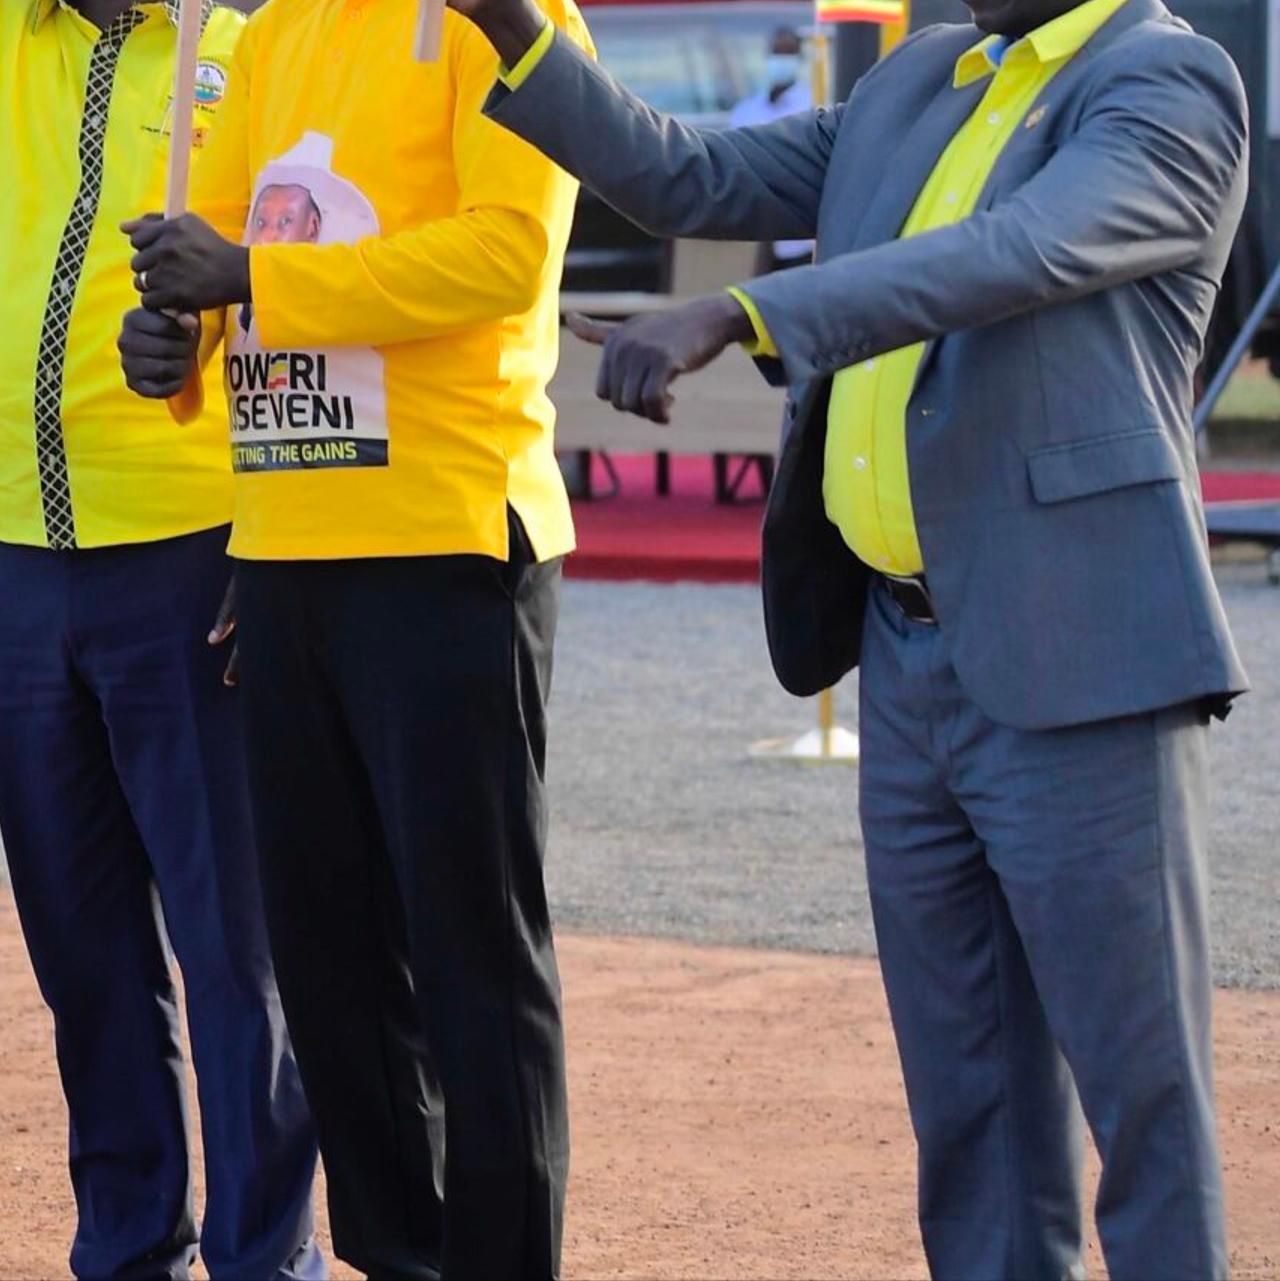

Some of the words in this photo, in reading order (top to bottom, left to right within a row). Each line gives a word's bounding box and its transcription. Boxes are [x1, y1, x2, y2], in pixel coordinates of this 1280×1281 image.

[226, 352, 326, 391] OWERI
[270, 444, 300, 463] THE
[301, 441, 357, 462] GAINS
